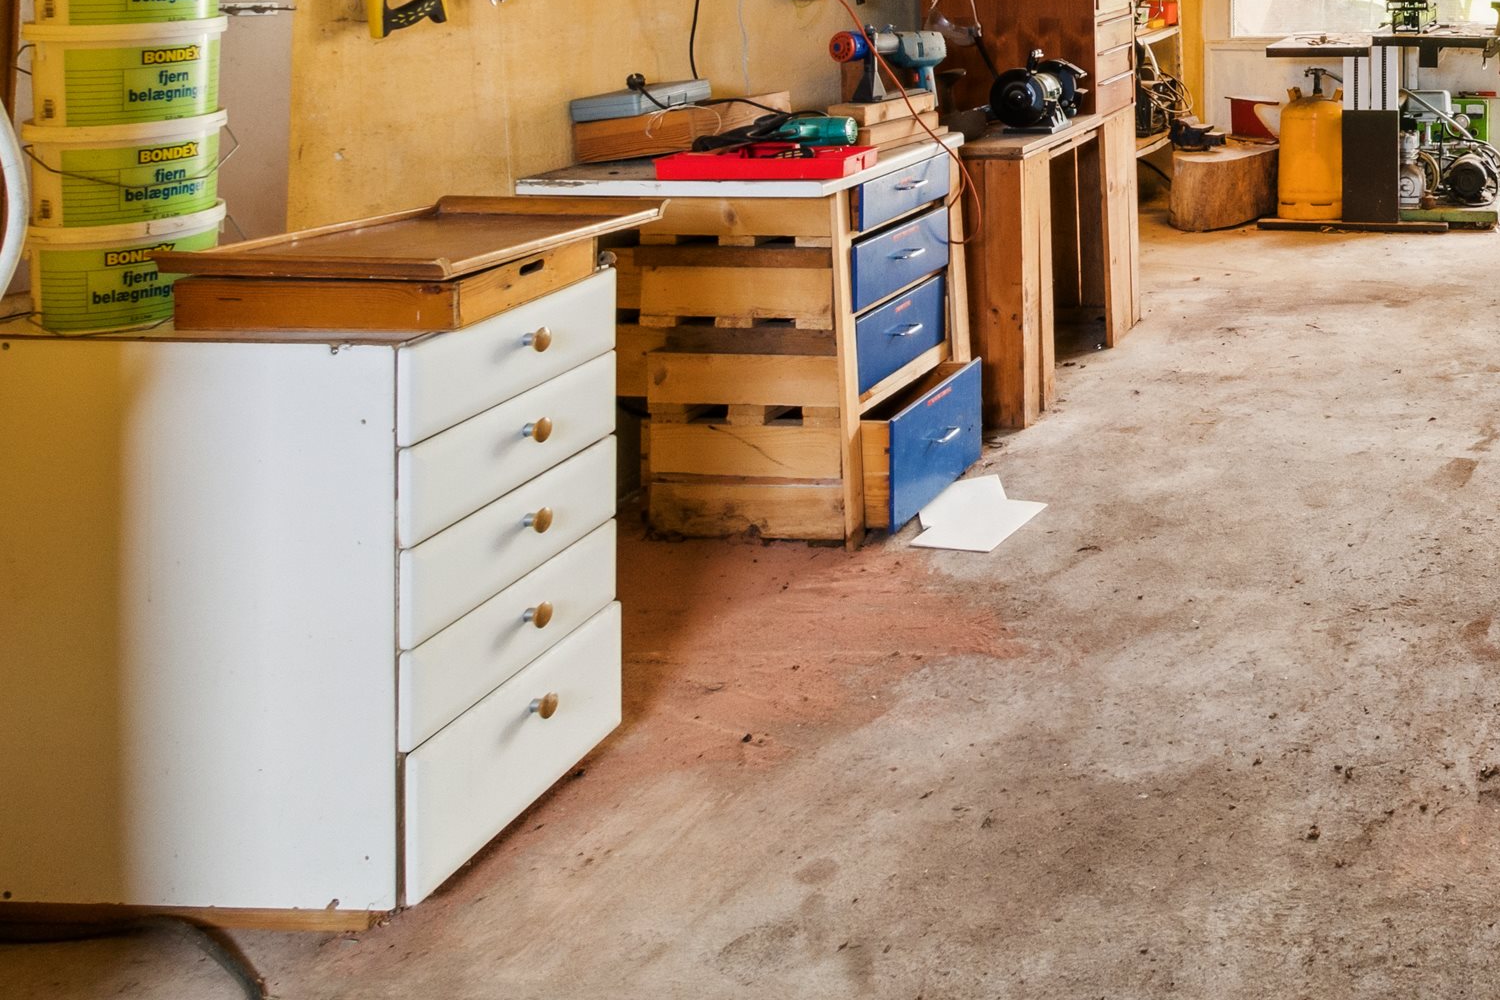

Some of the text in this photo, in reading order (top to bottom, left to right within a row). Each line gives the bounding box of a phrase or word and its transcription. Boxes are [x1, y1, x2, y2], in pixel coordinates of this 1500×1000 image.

[142, 45, 200, 65] BONDEX
[159, 70, 189, 86] fjern
[138, 142, 198, 164] BONDEX
[155, 168, 185, 183] fjern
[105, 243, 175, 267] BOND
[123, 270, 158, 287] fjern
[92, 284, 174, 304] belægning
